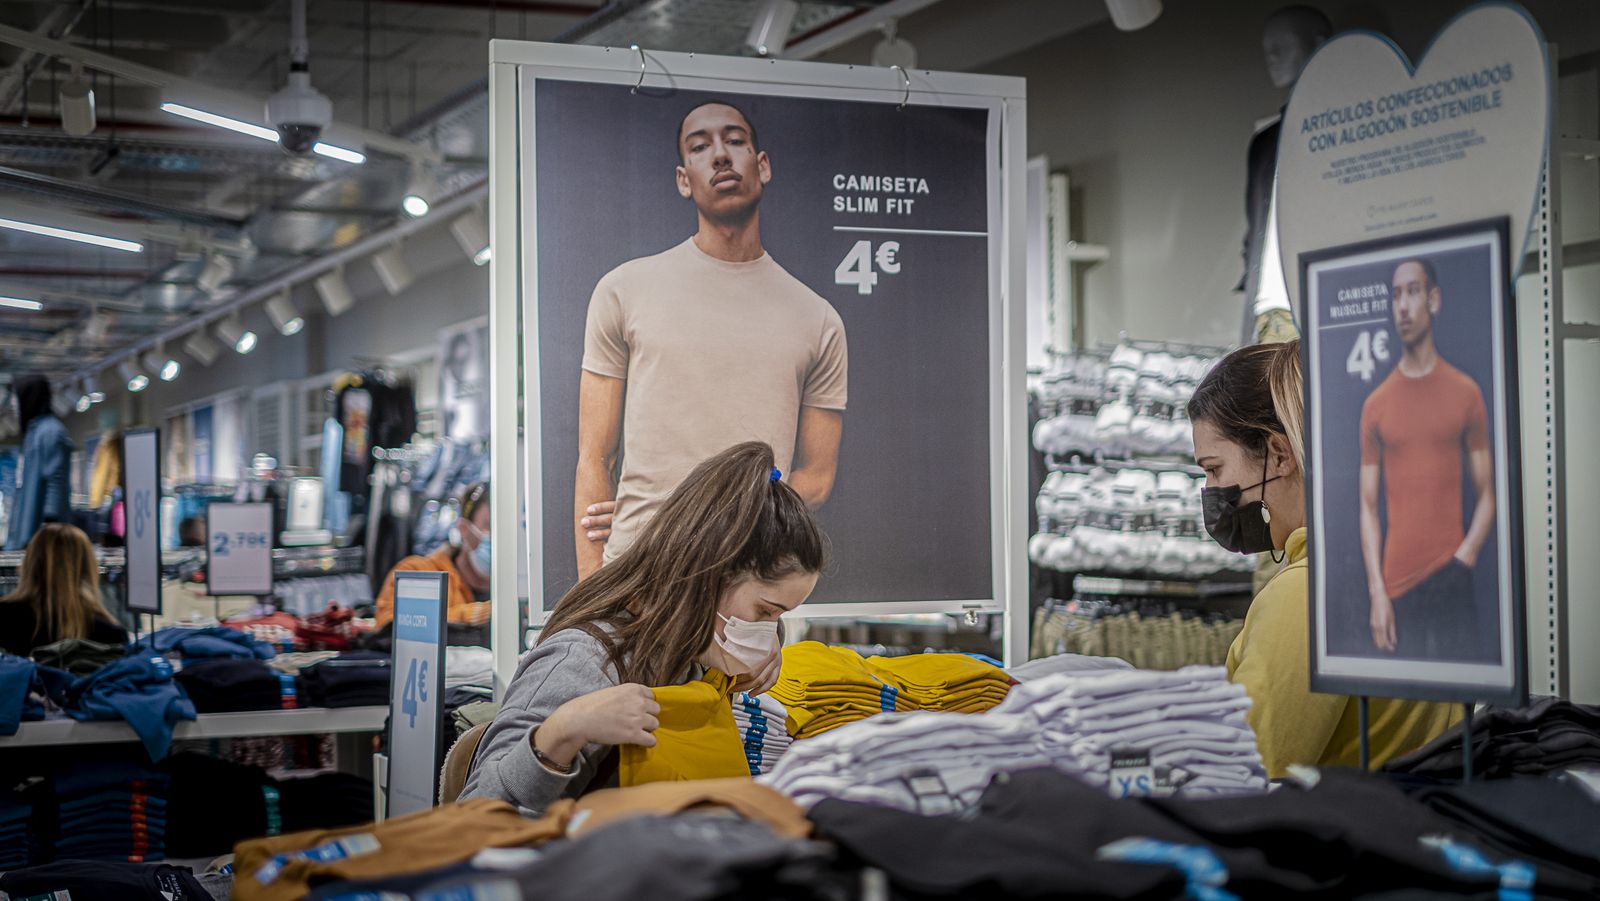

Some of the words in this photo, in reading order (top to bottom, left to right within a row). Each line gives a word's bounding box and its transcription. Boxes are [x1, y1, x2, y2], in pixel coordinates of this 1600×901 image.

[1301, 99, 1374, 134] ARTÍCULOS
[1376, 63, 1514, 114] CONFECCIONADOS
[1308, 132, 1337, 152] CON
[1339, 113, 1408, 145] ALGODÓN
[1409, 90, 1504, 128] SOSTENIBLE
[833, 174, 930, 194] CAMISETA
[833, 195, 879, 213] SLIM
[886, 198, 915, 215] FIT
[834, 240, 901, 295] 4€
[1337, 283, 1389, 302] CAMISETA
[1329, 301, 1369, 318] MUSCLE
[1371, 299, 1388, 313] FIT
[1346, 329, 1390, 381] 4€
[402, 657, 428, 728] 4€
